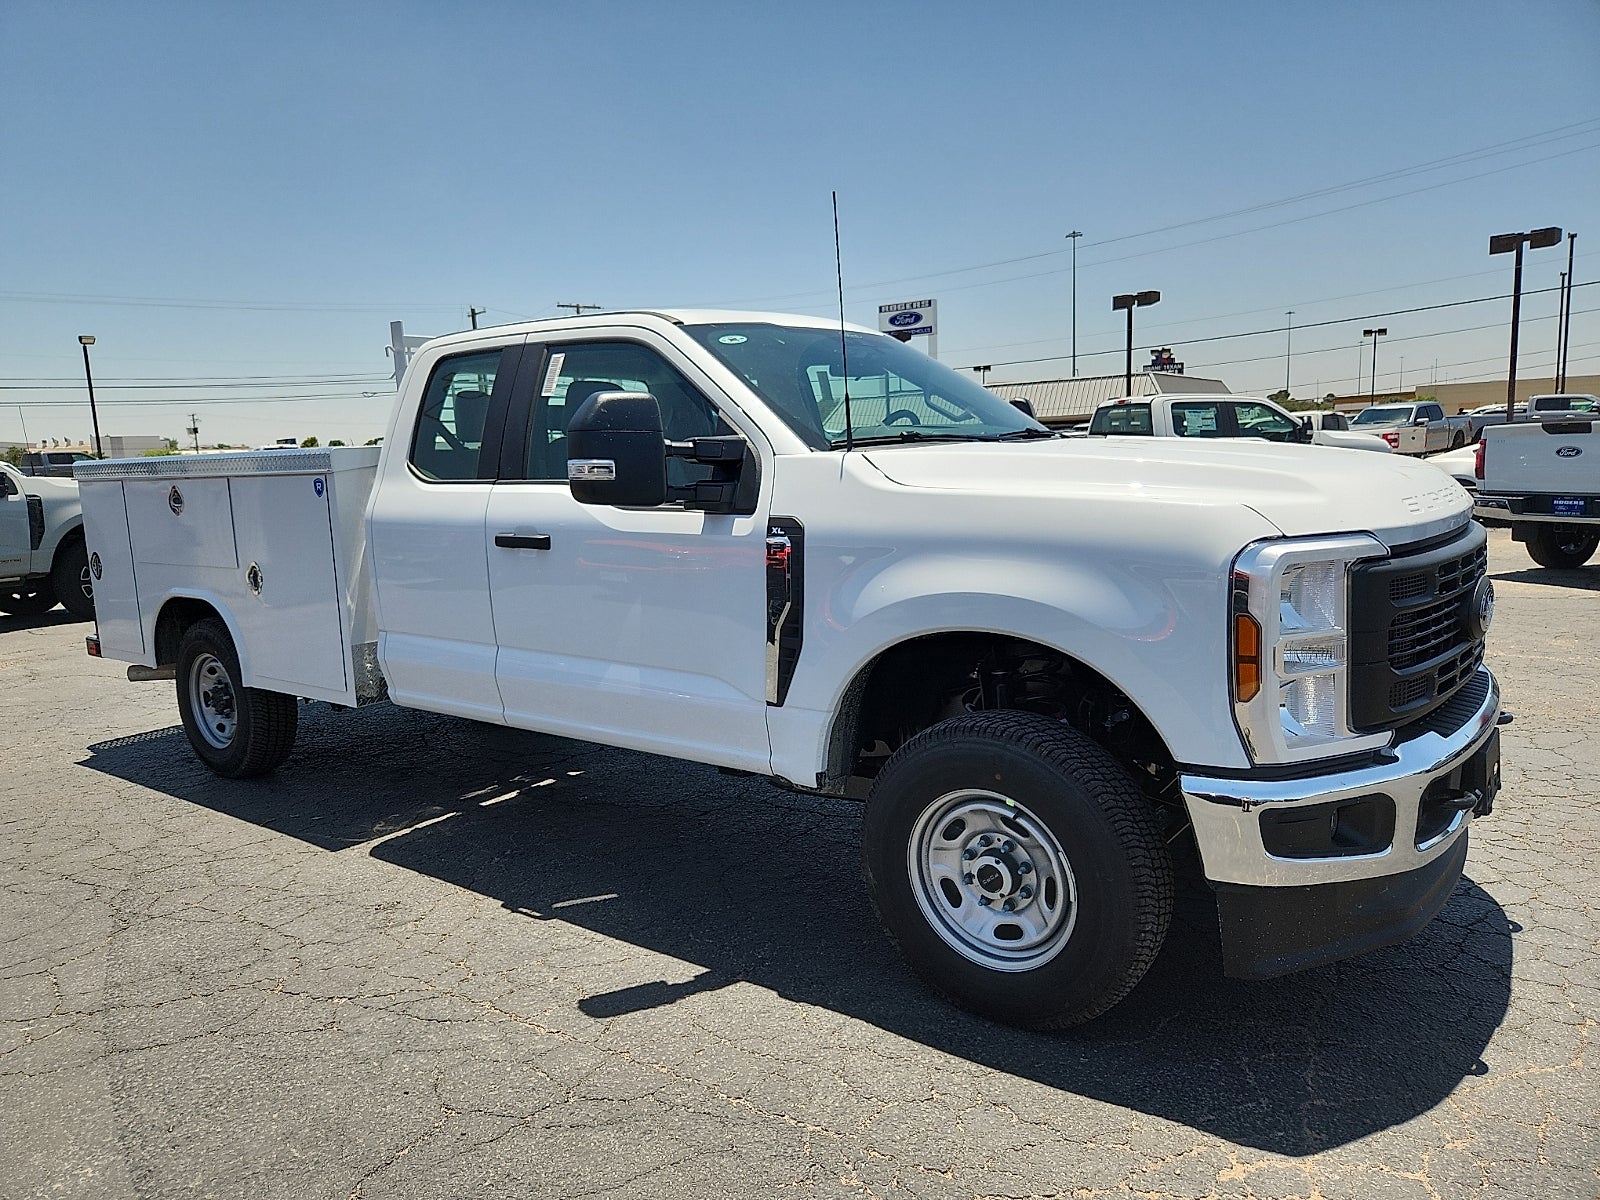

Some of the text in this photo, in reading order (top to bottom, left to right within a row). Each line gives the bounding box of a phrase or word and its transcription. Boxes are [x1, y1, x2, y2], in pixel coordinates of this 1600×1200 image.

[881, 300, 930, 312] ROGERS
[894, 314, 915, 325] Ford
[1559, 448, 1577, 456] Ford
